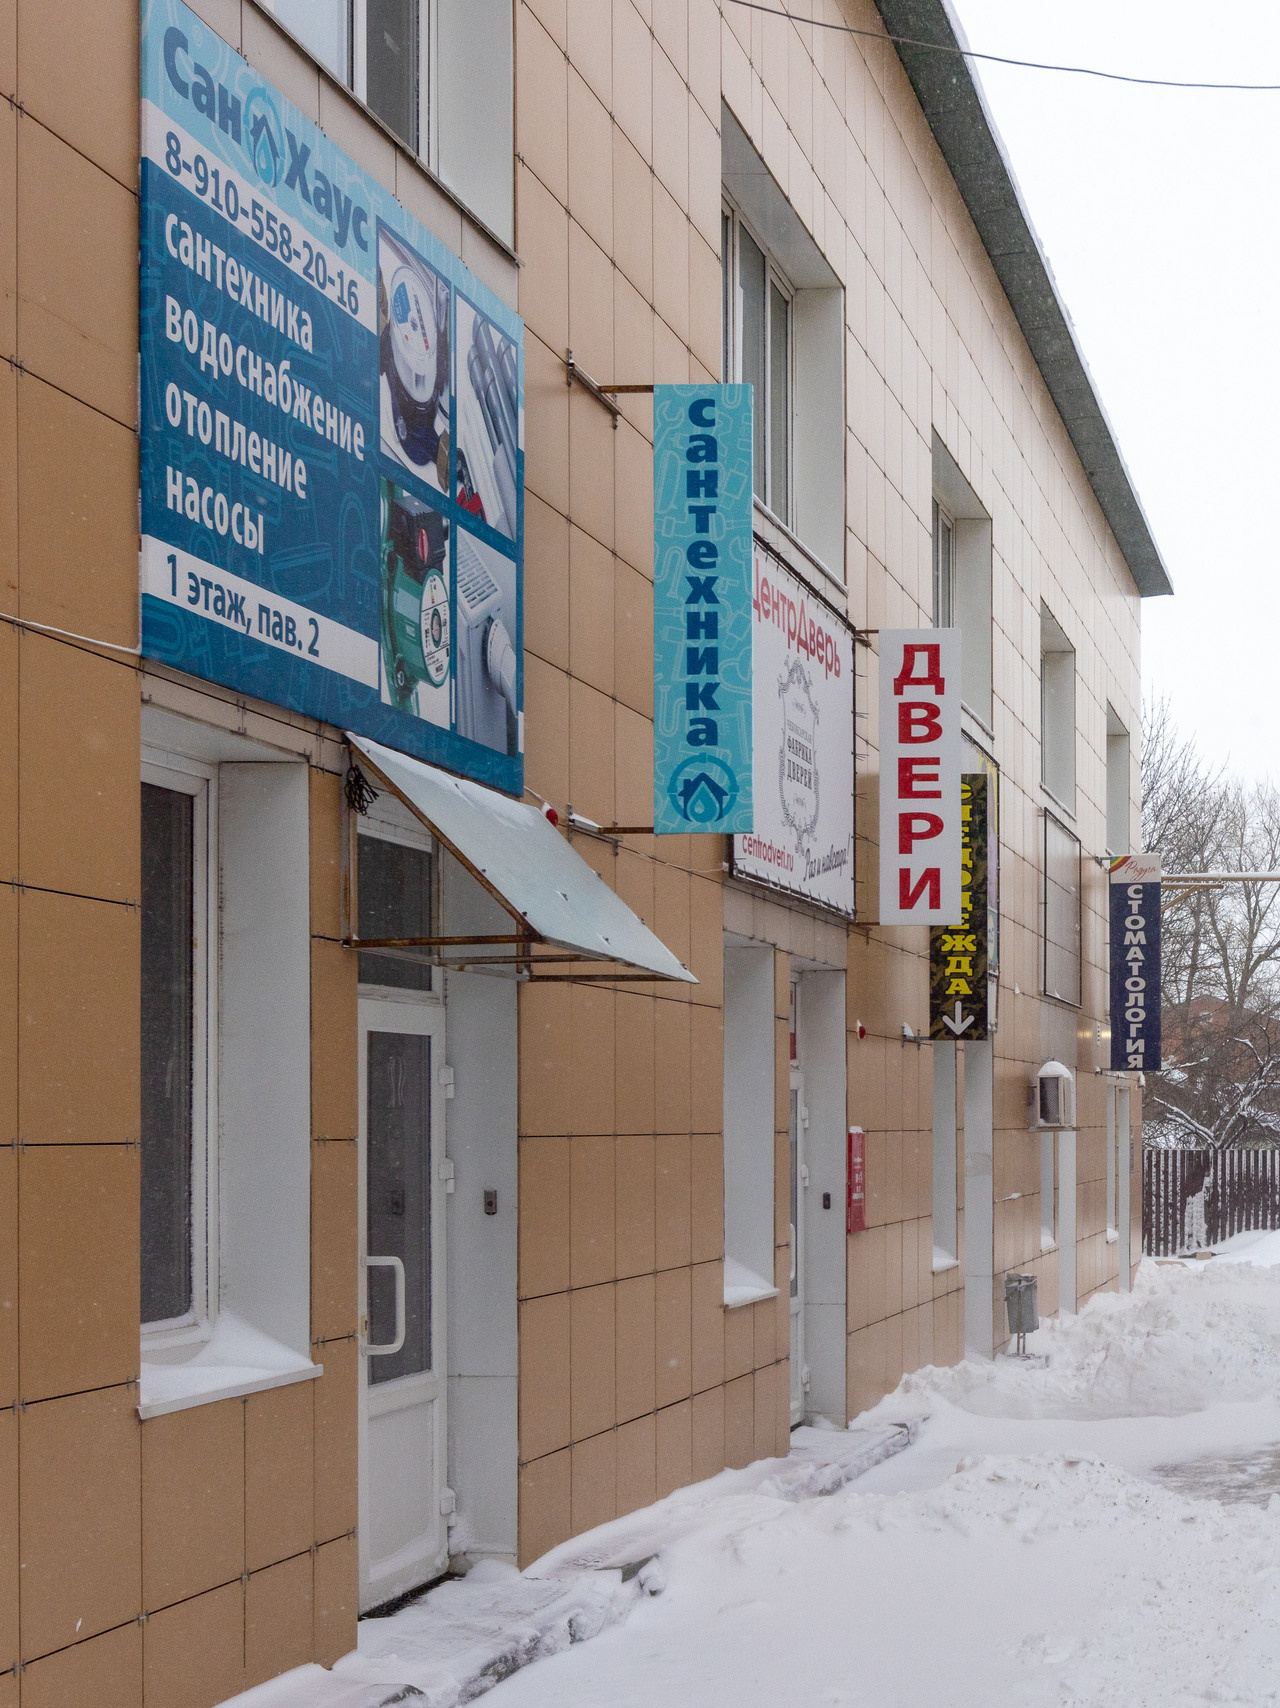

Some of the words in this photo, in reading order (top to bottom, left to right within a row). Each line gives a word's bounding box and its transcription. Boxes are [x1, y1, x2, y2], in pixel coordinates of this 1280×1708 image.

[164, 130, 360, 316] 8-910-558-20-16
[164, 213, 314, 354] сантехника
[164, 294, 366, 461] водоснабжение
[164, 386, 308, 499] отопление
[165, 465, 265, 556] насосы
[167, 553, 178, 598] 1
[186, 570, 252, 635] этаж,
[257, 604, 304, 651] пав.
[307, 617, 321, 658] 2
[684, 398, 720, 747] сантехника
[786, 735, 813, 766] ФАБРИКА
[786, 758, 813, 791] ДВЕРЕЙ
[893, 643, 946, 911] ДВЕРИ
[742, 834, 793, 872] centrodveri.ru
[803, 846, 816, 882] Раз
[1124, 860, 1159, 882] Радуга
[1123, 884, 1146, 1069] СТОМАТОЛОГИЯ
